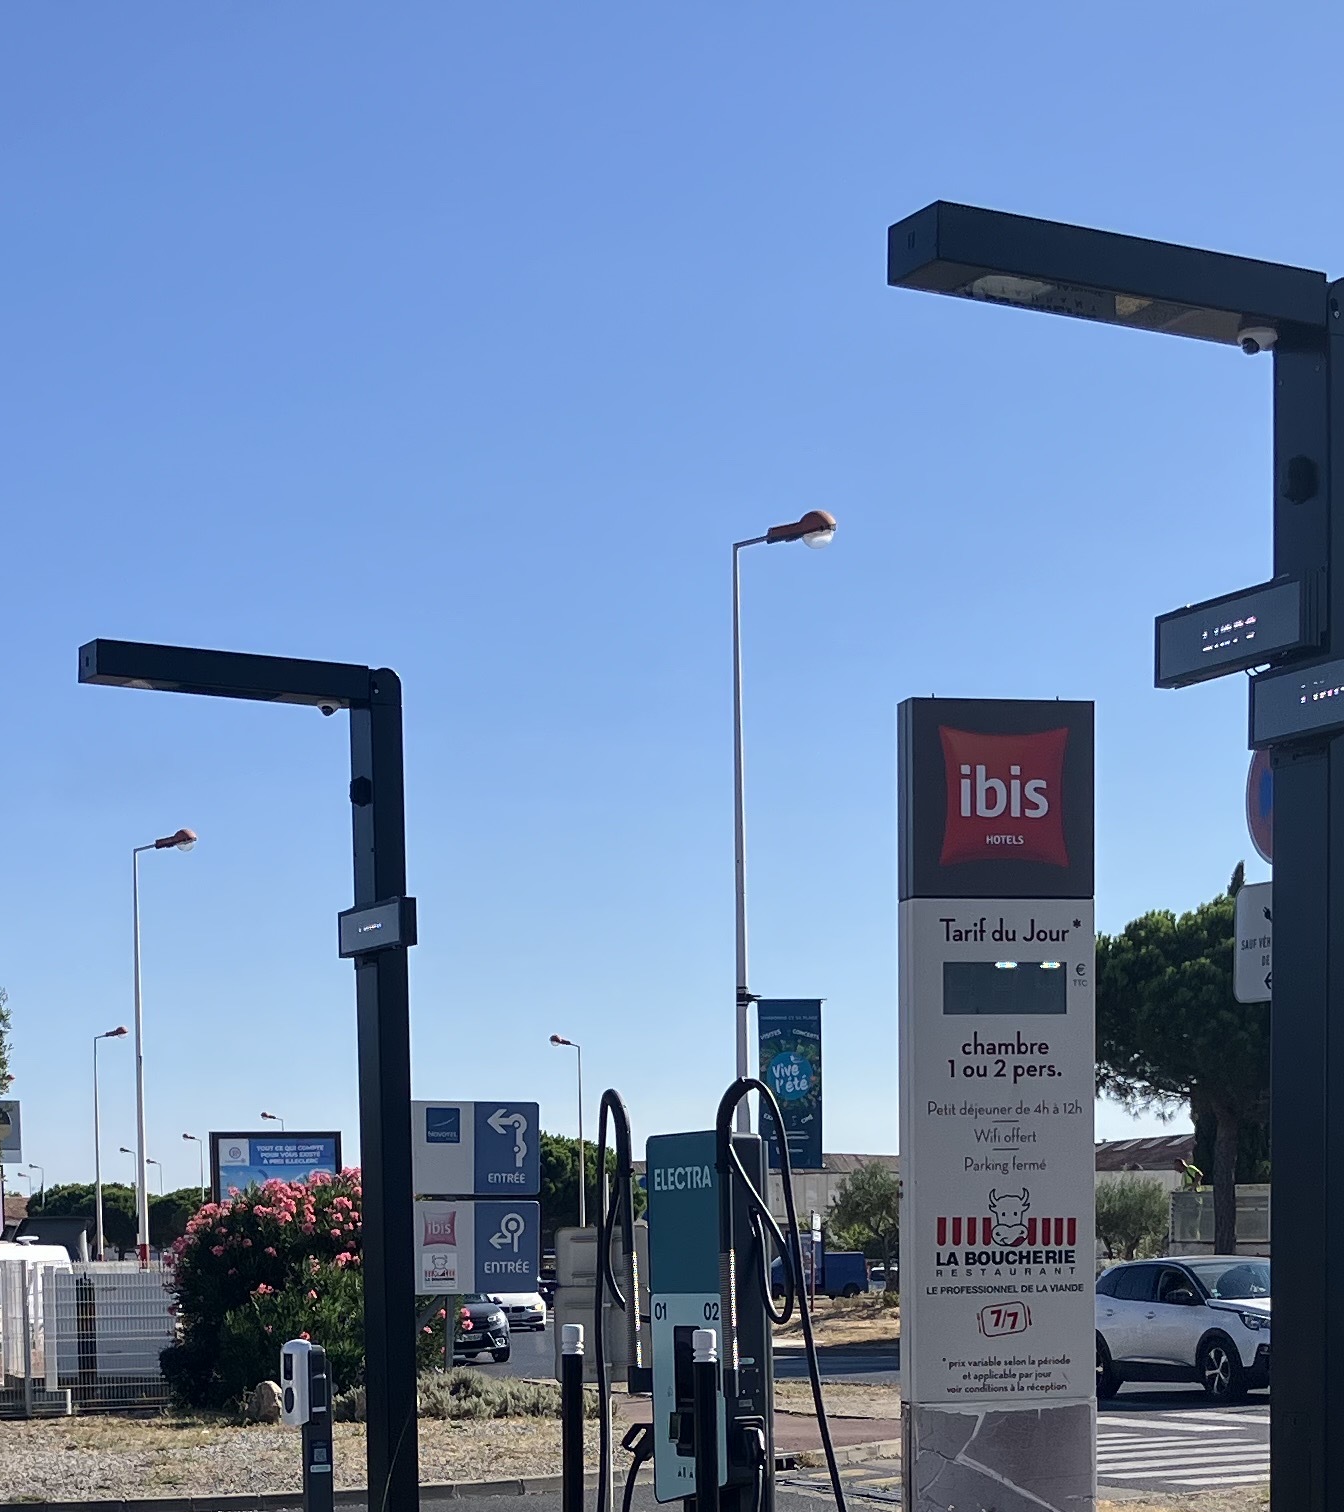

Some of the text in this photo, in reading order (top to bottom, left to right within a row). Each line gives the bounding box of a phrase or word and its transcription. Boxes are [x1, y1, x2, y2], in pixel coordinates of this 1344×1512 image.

[960, 764, 1049, 819] ibis
[986, 835, 1024, 846] HOTELS
[939, 917, 988, 943] Tarif
[991, 918, 1017, 943] du
[1241, 938, 1257, 950] SAUF
[1075, 963, 1086, 977] €
[1072, 979, 1088, 987] TTC
[961, 1031, 1050, 1056] chambre
[772, 1063, 800, 1078] Vive
[948, 1059, 1062, 1084] 1 ou 2 pers.
[775, 1074, 809, 1094] l'été
[927, 1099, 1083, 1120] Petit déjeuner de 4h à 12h
[974, 1127, 1037, 1143] Wifi offert
[964, 1155, 1047, 1175] Parking fermé
[487, 1171, 526, 1184] ENTRÉE
[653, 1165, 712, 1191] ELECTRA
[427, 1219, 452, 1235] ibis
[484, 1258, 530, 1274] ENTRÉE
[936, 1250, 1076, 1267] LA BOUCHERIE
[936, 1266, 1076, 1277] RESTAURANT
[926, 1283, 1084, 1295] LE PROFESSIONNEL DE LA VIANDE
[654, 1302, 720, 1321] 01 02
[990, 1309, 1019, 1330] 7/7
[948, 1354, 1071, 1368] prix variable selon la période
[962, 1369, 1052, 1382] et applicable par jour
[946, 1384, 962, 1393] voir
[964, 1382, 1008, 1393] conditions
[1017, 1382, 1025, 1391] la
[1026, 1383, 1068, 1393] réception
